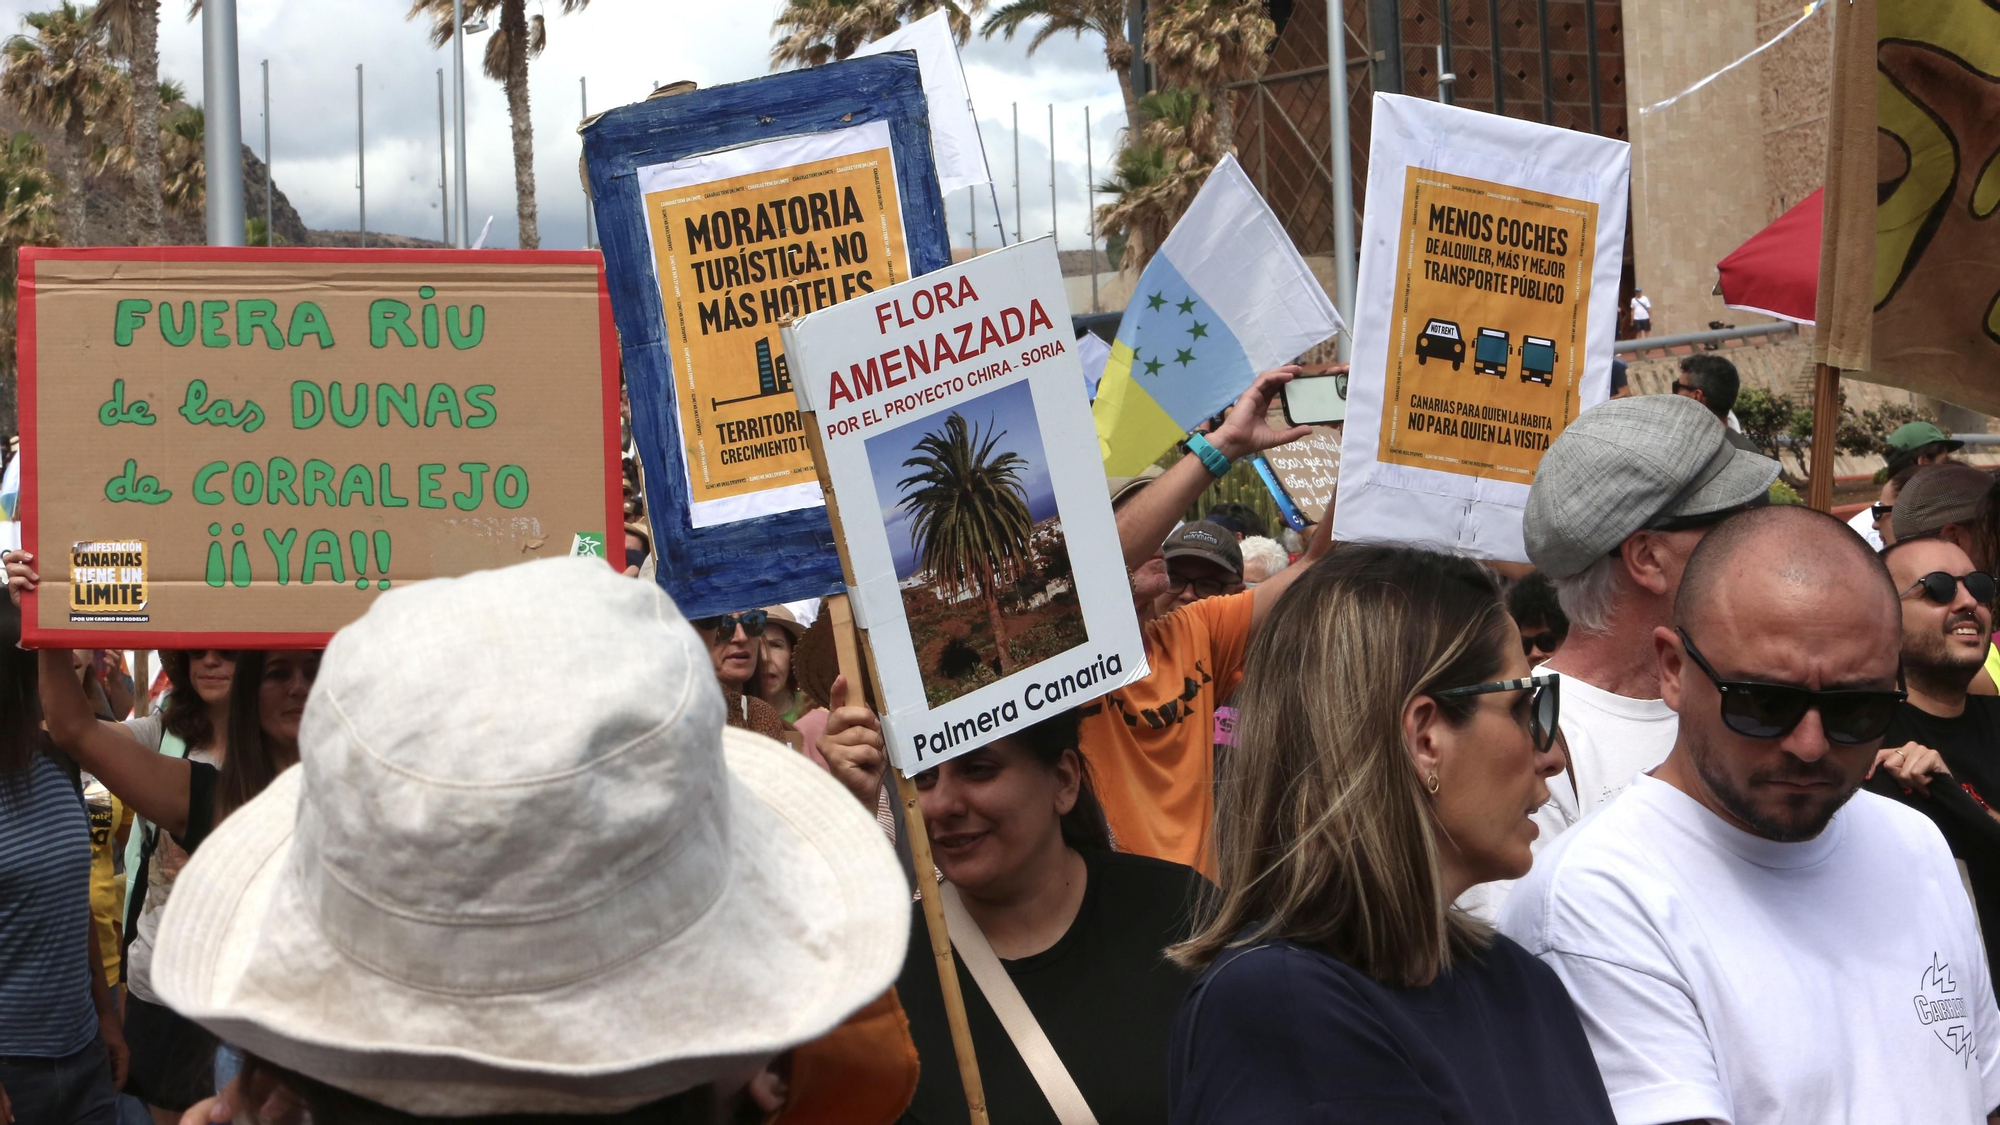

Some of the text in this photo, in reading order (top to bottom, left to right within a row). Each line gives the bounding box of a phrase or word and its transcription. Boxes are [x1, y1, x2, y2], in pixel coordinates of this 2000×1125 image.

[685, 186, 864, 255] MORATORIA
[1428, 203, 1568, 256] MENOS COCHES
[691, 231, 868, 294] TURÍSTICA: NO
[1424, 260, 1564, 304] TRANSPORTE PÚBLICO
[1426, 237, 1566, 279] DE ALQUILER, MÁS Y MEJOR
[114, 298, 334, 350] FUERA
[698, 290, 758, 336] MÁS
[875, 275, 979, 335] FLORA
[828, 298, 1054, 410] AMENAZADA
[1431, 324, 1454, 336] NOT RENT
[99, 379, 496, 432] de las DUNAS
[826, 416, 860, 440] POR
[862, 409, 882, 426] EL
[884, 376, 964, 418] PROYECTO
[967, 359, 1012, 387] CHIRA
[1020, 340, 1066, 367] SORIA
[1410, 394, 1552, 430] CANARIAS PARA QUIEN LA HABITA
[716, 410, 802, 444] TERRITORI
[720, 436, 810, 465] CRECIMIENTO T
[1408, 412, 1550, 451] NO PARA QUIEN LA VISITA
[104, 456, 529, 511] de CORRALEJO
[1272, 457, 1304, 470] cosas
[73, 553, 142, 567] CANARIAS
[74, 568, 142, 583] TIENE UN
[205, 522, 392, 590] ¡¡YA!!
[913, 700, 1018, 762] Palmera
[1024, 654, 1122, 711] Canaria
